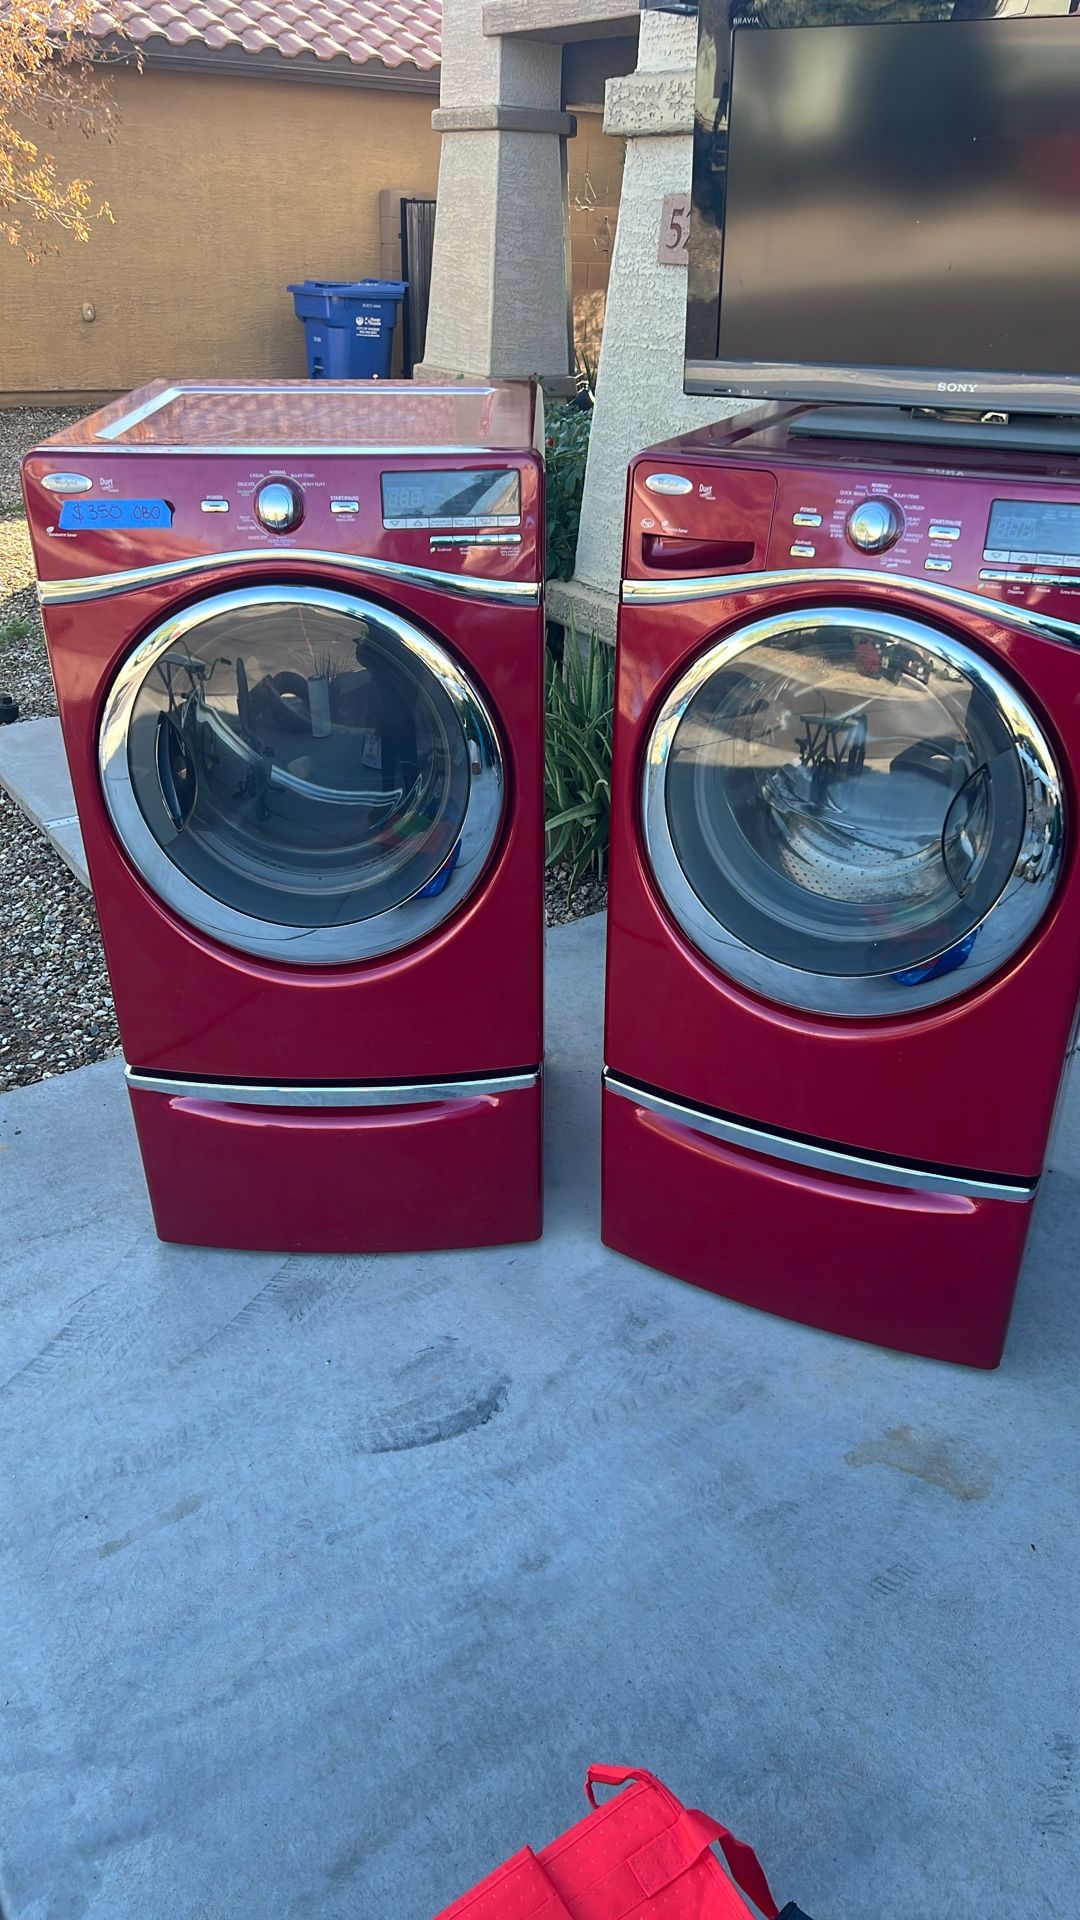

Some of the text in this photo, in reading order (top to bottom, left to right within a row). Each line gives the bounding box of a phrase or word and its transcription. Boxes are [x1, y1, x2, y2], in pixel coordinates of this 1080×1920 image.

[733, 16, 759, 25] BRAVIA
[665, 207, 692, 249] 5
[937, 382, 978, 393] SONY
[99, 477, 113, 487] Duet
[699, 483, 713, 493] Duet
[72, 503, 161, 524] $350 OBO
[929, 518, 962, 526] START/PAUSE
